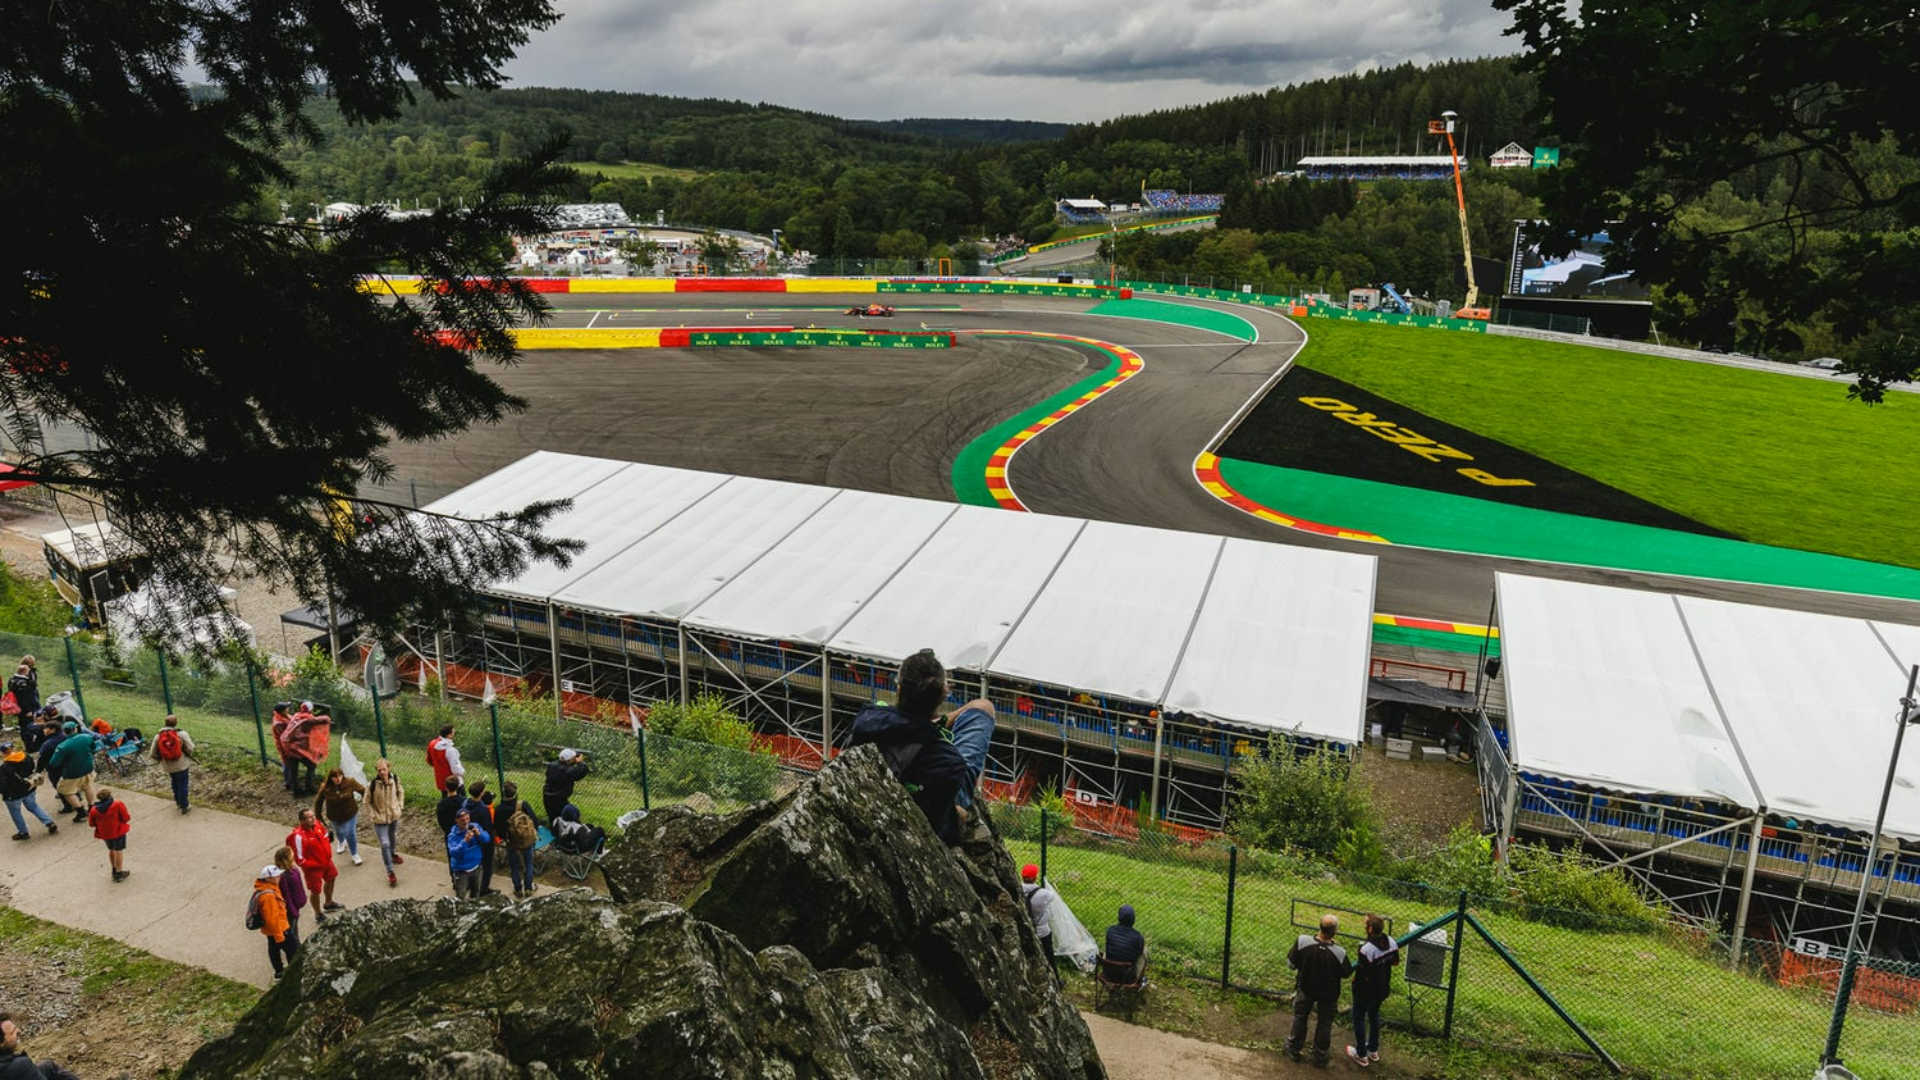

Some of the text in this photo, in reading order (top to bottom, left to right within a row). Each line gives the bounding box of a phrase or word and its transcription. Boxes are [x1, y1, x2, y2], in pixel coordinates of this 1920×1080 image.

[1298, 397, 1536, 486] P ZERO
[1081, 792, 1092, 803] D
[1804, 942, 1820, 954] B
